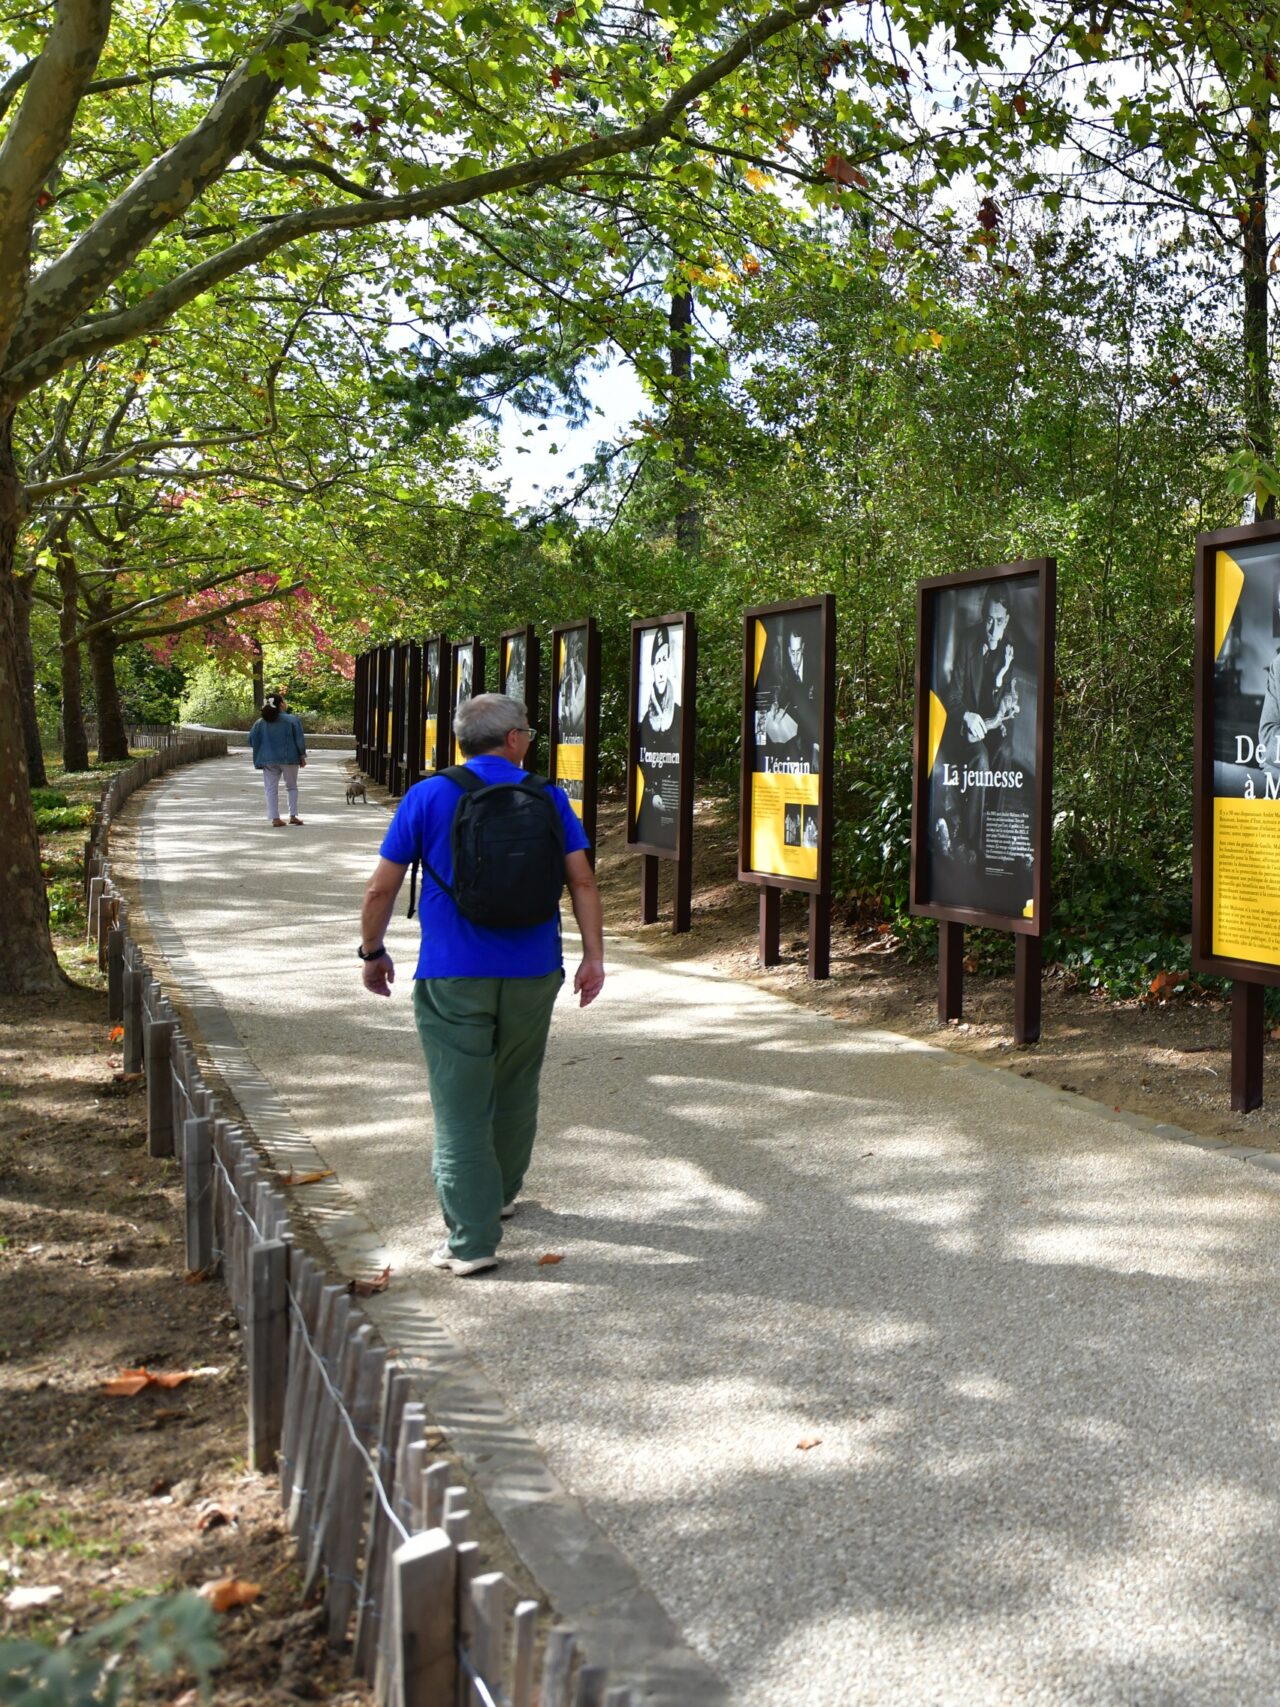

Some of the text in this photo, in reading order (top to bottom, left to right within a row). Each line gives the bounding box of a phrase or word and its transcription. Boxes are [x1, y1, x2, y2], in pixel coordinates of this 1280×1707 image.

[1235, 735, 1267, 764] De
[765, 756, 810, 774] L'écrivain
[942, 764, 1024, 793] La jeunesse
[1244, 773, 1256, 800] à
